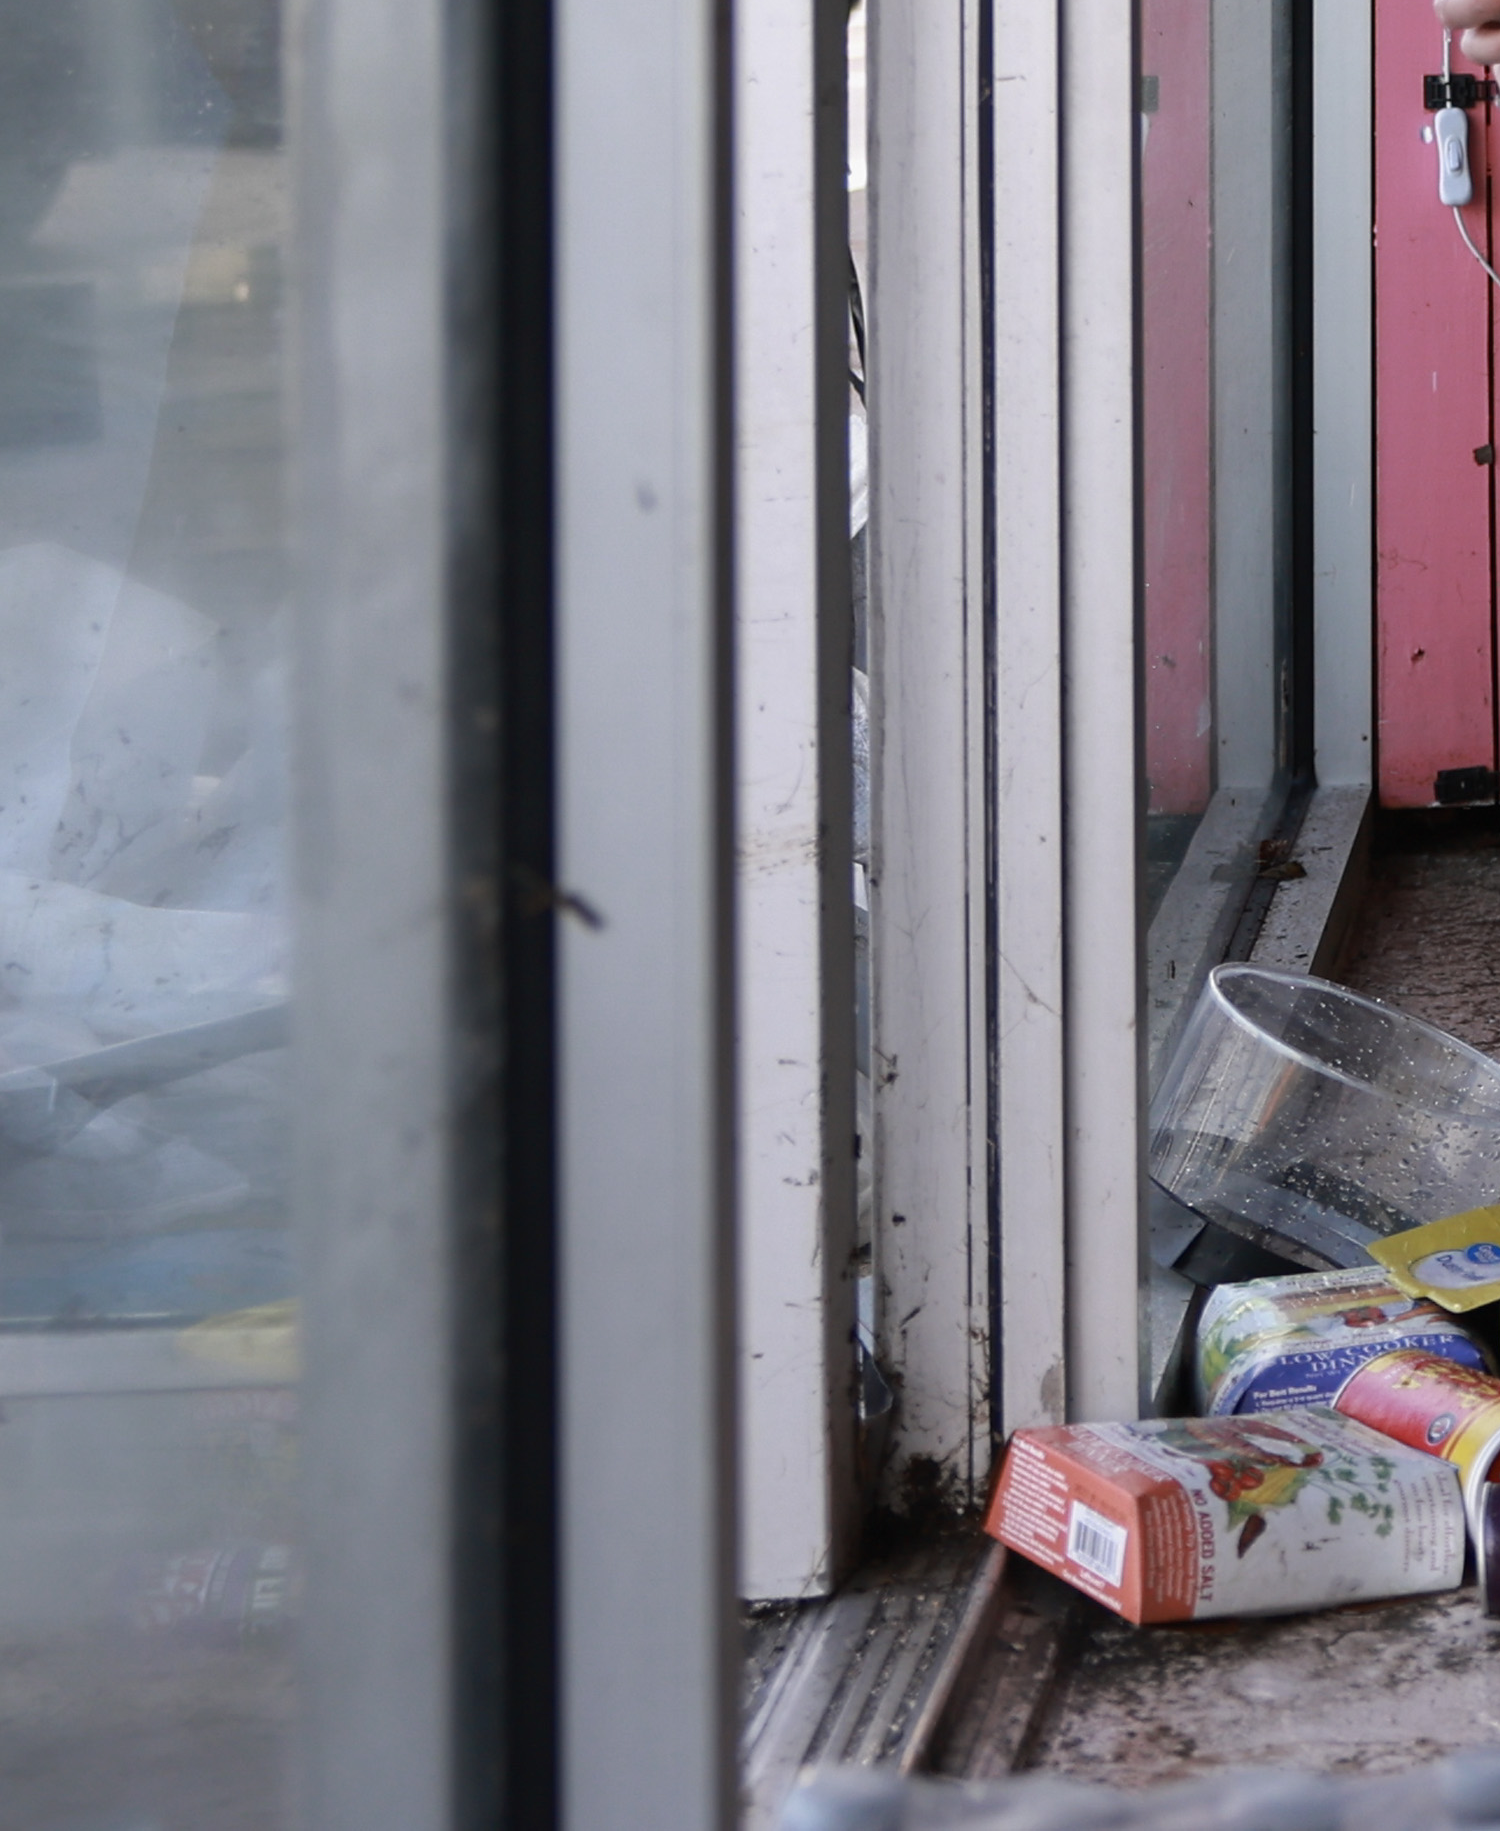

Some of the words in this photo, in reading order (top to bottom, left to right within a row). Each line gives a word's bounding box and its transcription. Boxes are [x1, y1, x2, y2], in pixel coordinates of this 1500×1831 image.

[1345, 1335, 1455, 1355] COOKER
[1192, 1488, 1206, 1507] NO
[1198, 1511, 1215, 1560] ADDED
[1199, 1565, 1215, 1602] SALT
